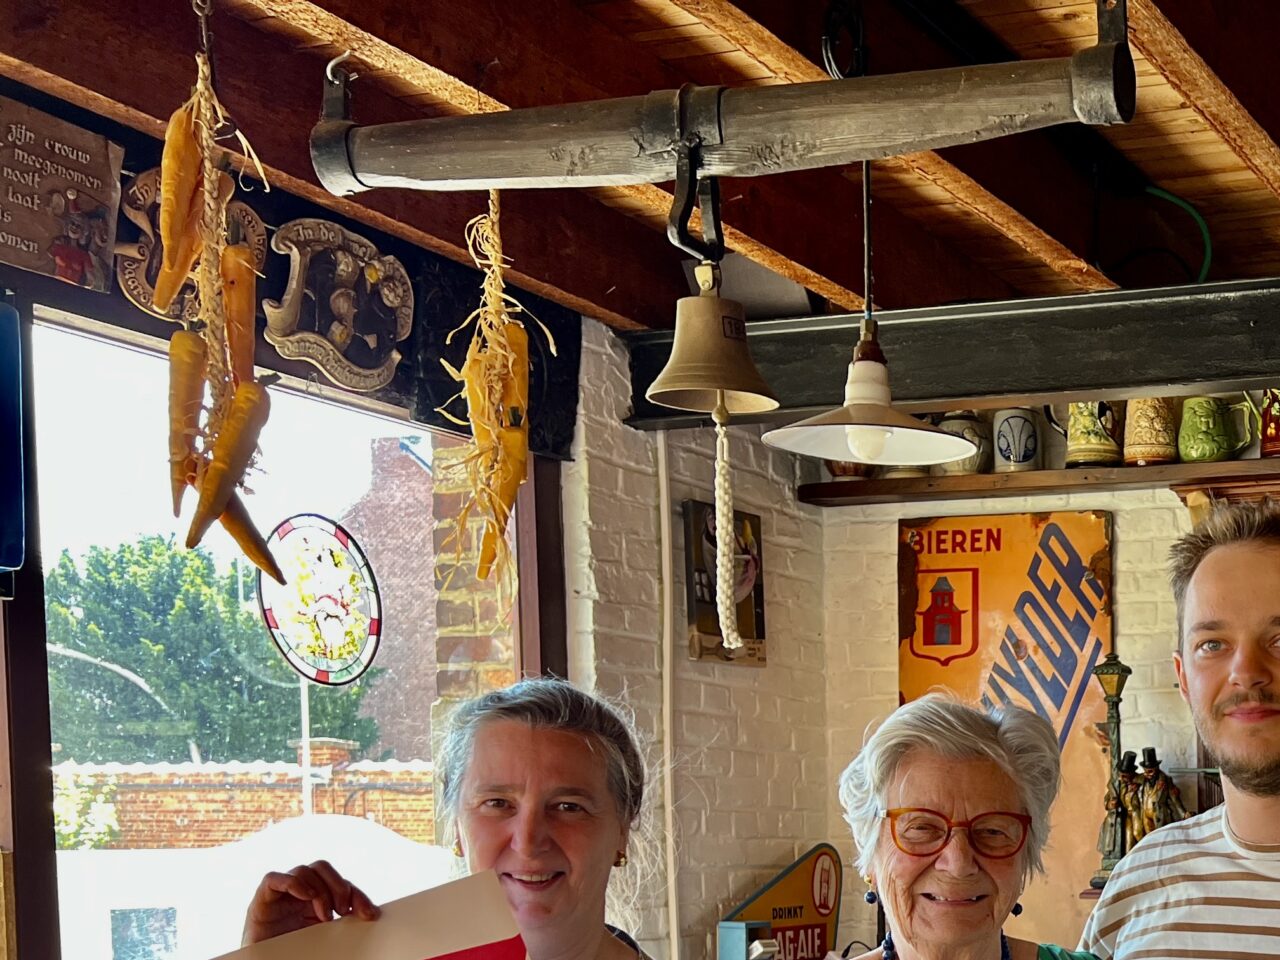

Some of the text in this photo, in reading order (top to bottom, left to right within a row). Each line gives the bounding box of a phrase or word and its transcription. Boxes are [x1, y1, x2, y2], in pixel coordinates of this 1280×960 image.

[3, 165, 41, 189] nooit
[14, 147, 103, 191] meegenomen
[7, 186, 41, 212] laat
[911, 527, 1002, 555] BIEREN
[772, 905, 804, 920] DRINKT
